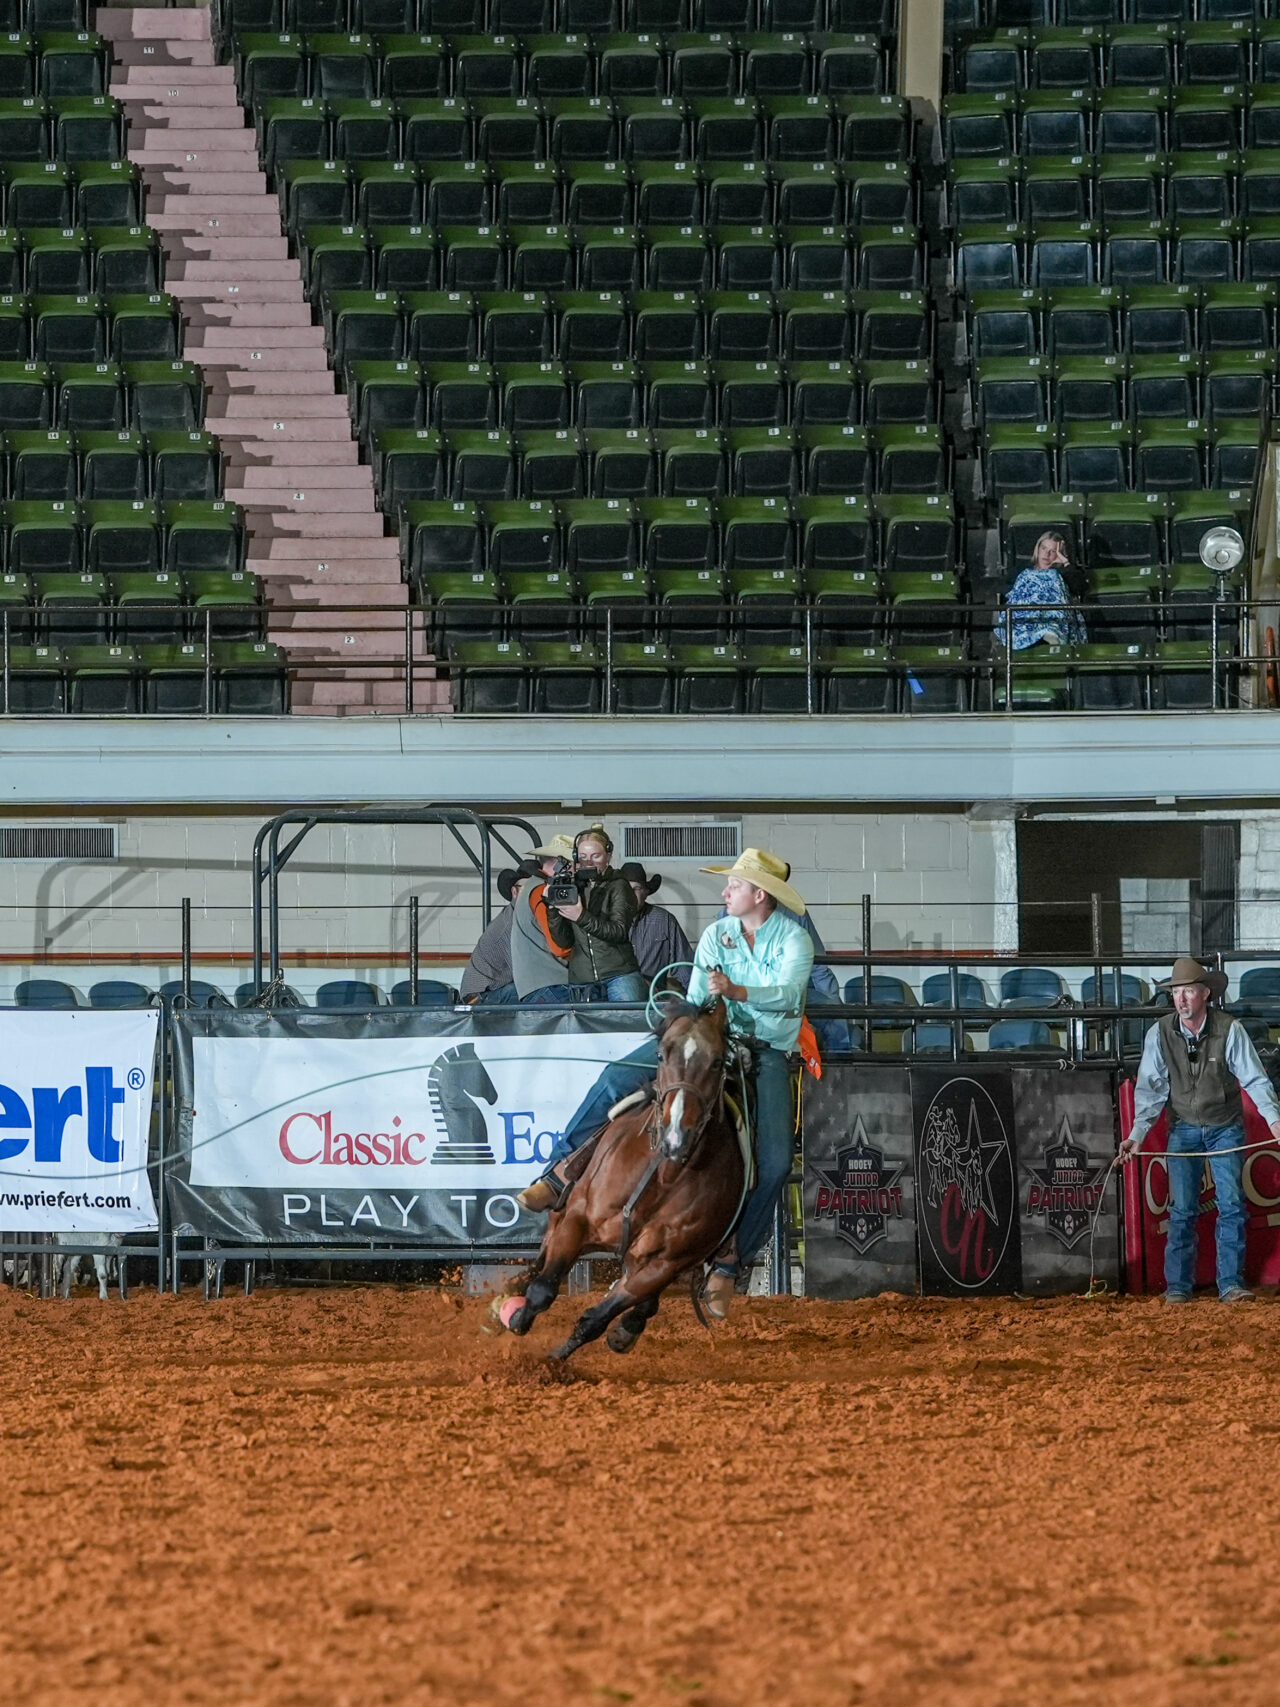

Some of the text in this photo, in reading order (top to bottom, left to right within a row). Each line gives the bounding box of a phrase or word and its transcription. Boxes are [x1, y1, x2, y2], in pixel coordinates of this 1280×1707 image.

[279, 1110, 427, 1166] Classic
[848, 1159, 873, 1170] HOOEY
[1055, 1157, 1078, 1168] HOOEY
[842, 1171, 879, 1187] JUNIOR
[1051, 1170, 1084, 1185] JUNIOR
[282, 1193, 520, 1228] PLAY TO
[814, 1185, 903, 1219] PATRIOT
[1026, 1183, 1106, 1216] PATRIOT
